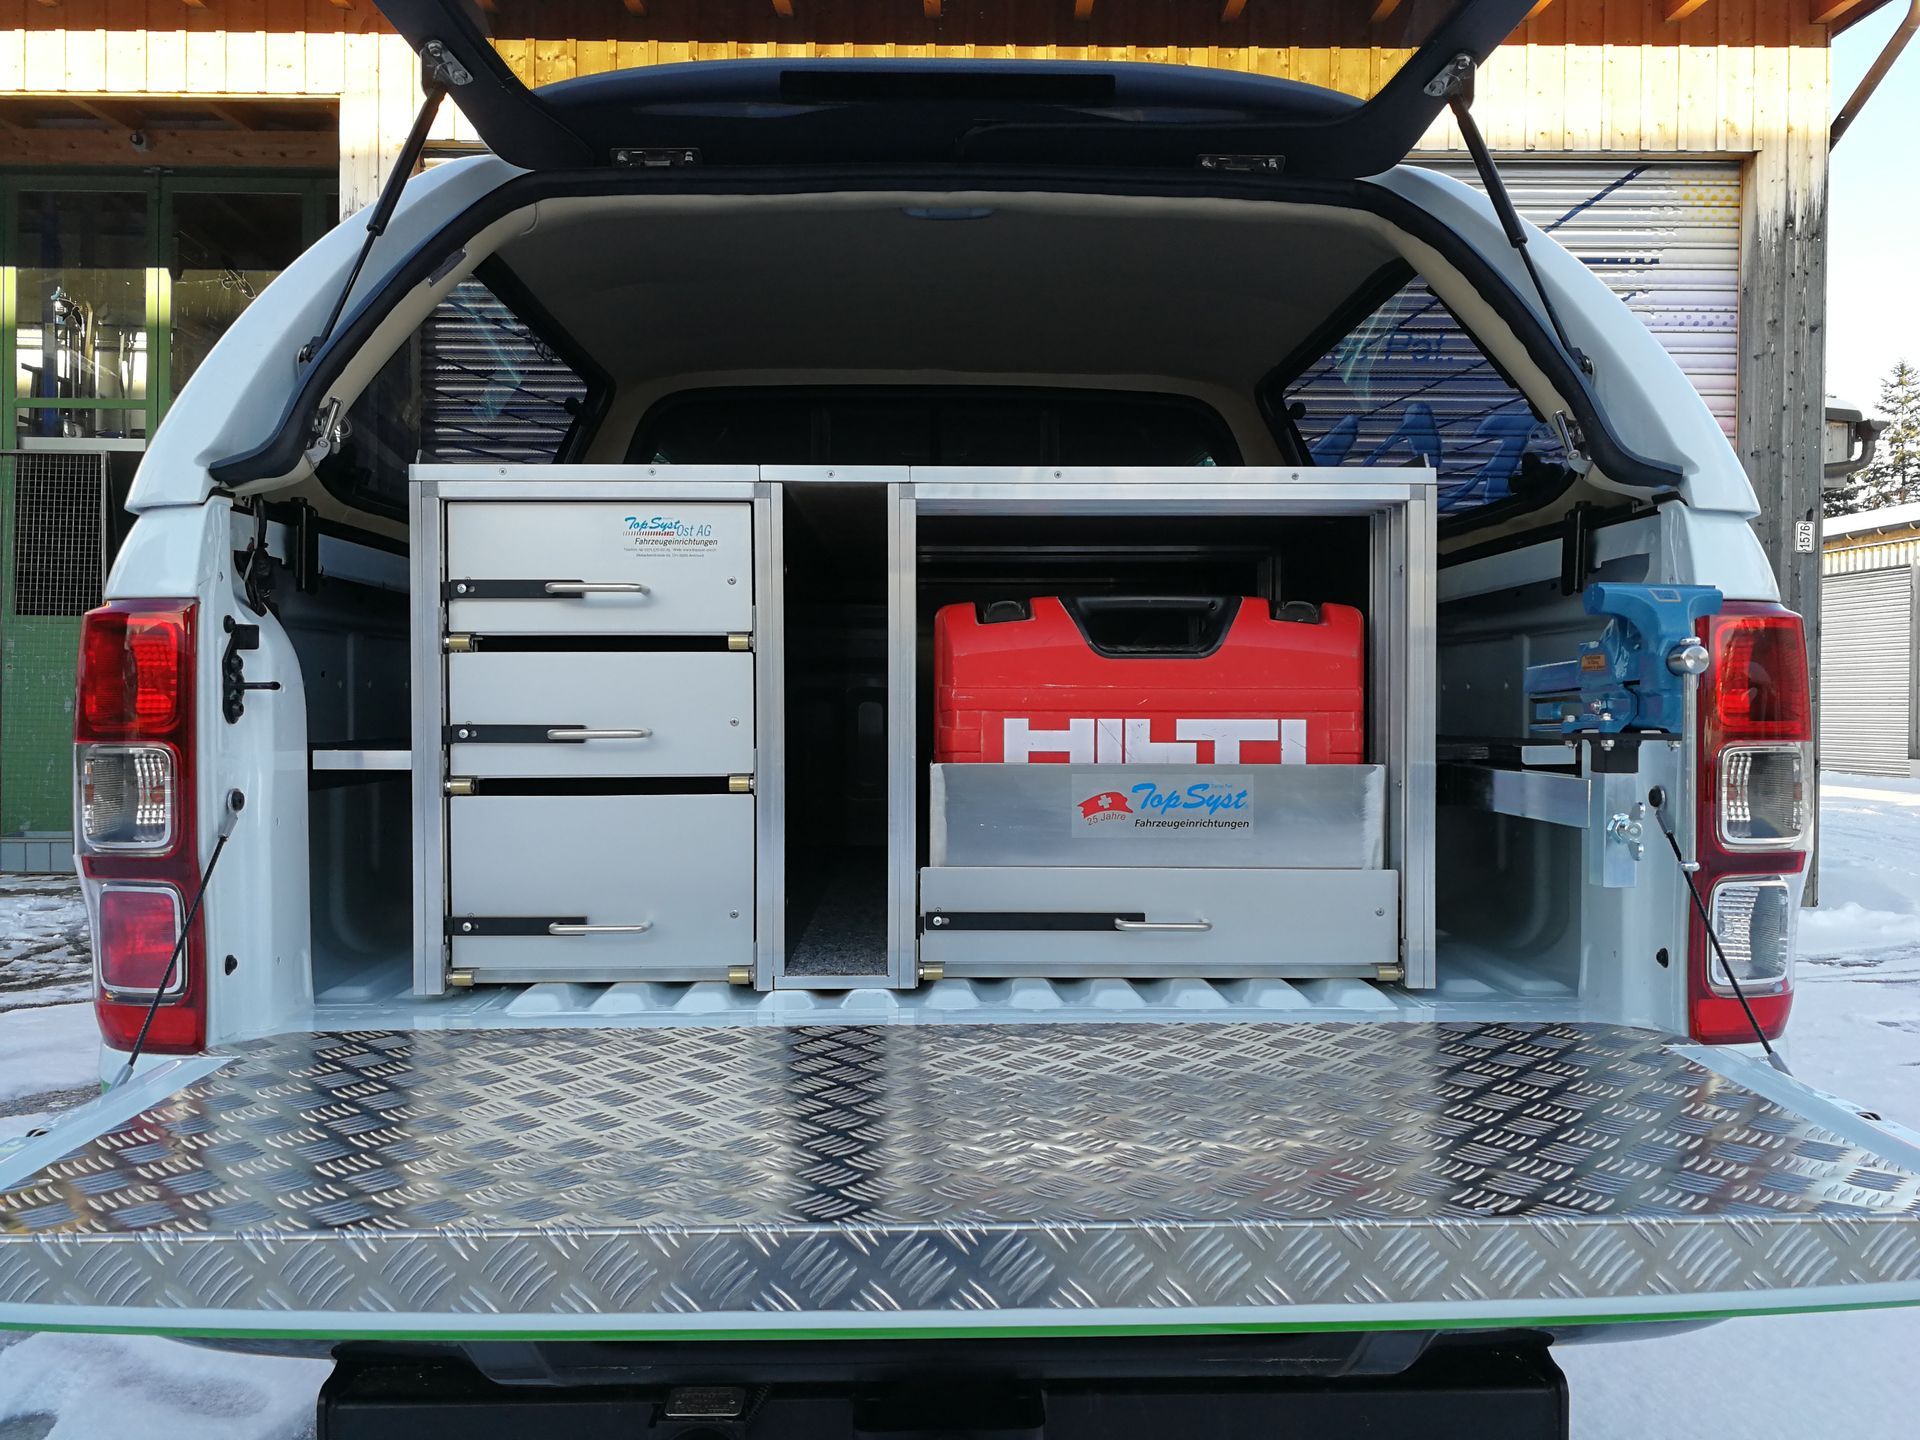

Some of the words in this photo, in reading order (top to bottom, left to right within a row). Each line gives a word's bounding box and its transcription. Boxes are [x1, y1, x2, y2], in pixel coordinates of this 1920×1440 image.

[676, 524, 694, 537] Ost
[696, 524, 712, 537] AG
[1799, 525, 1811, 549] 1576
[634, 537, 718, 547] Fahrzeugeinrichtungen
[1003, 718, 1308, 765] HILTI
[1086, 816, 1099, 827] 25
[1100, 811, 1127, 823] Jahre
[1134, 819, 1250, 830] Fahrzeugeinrichtungen
